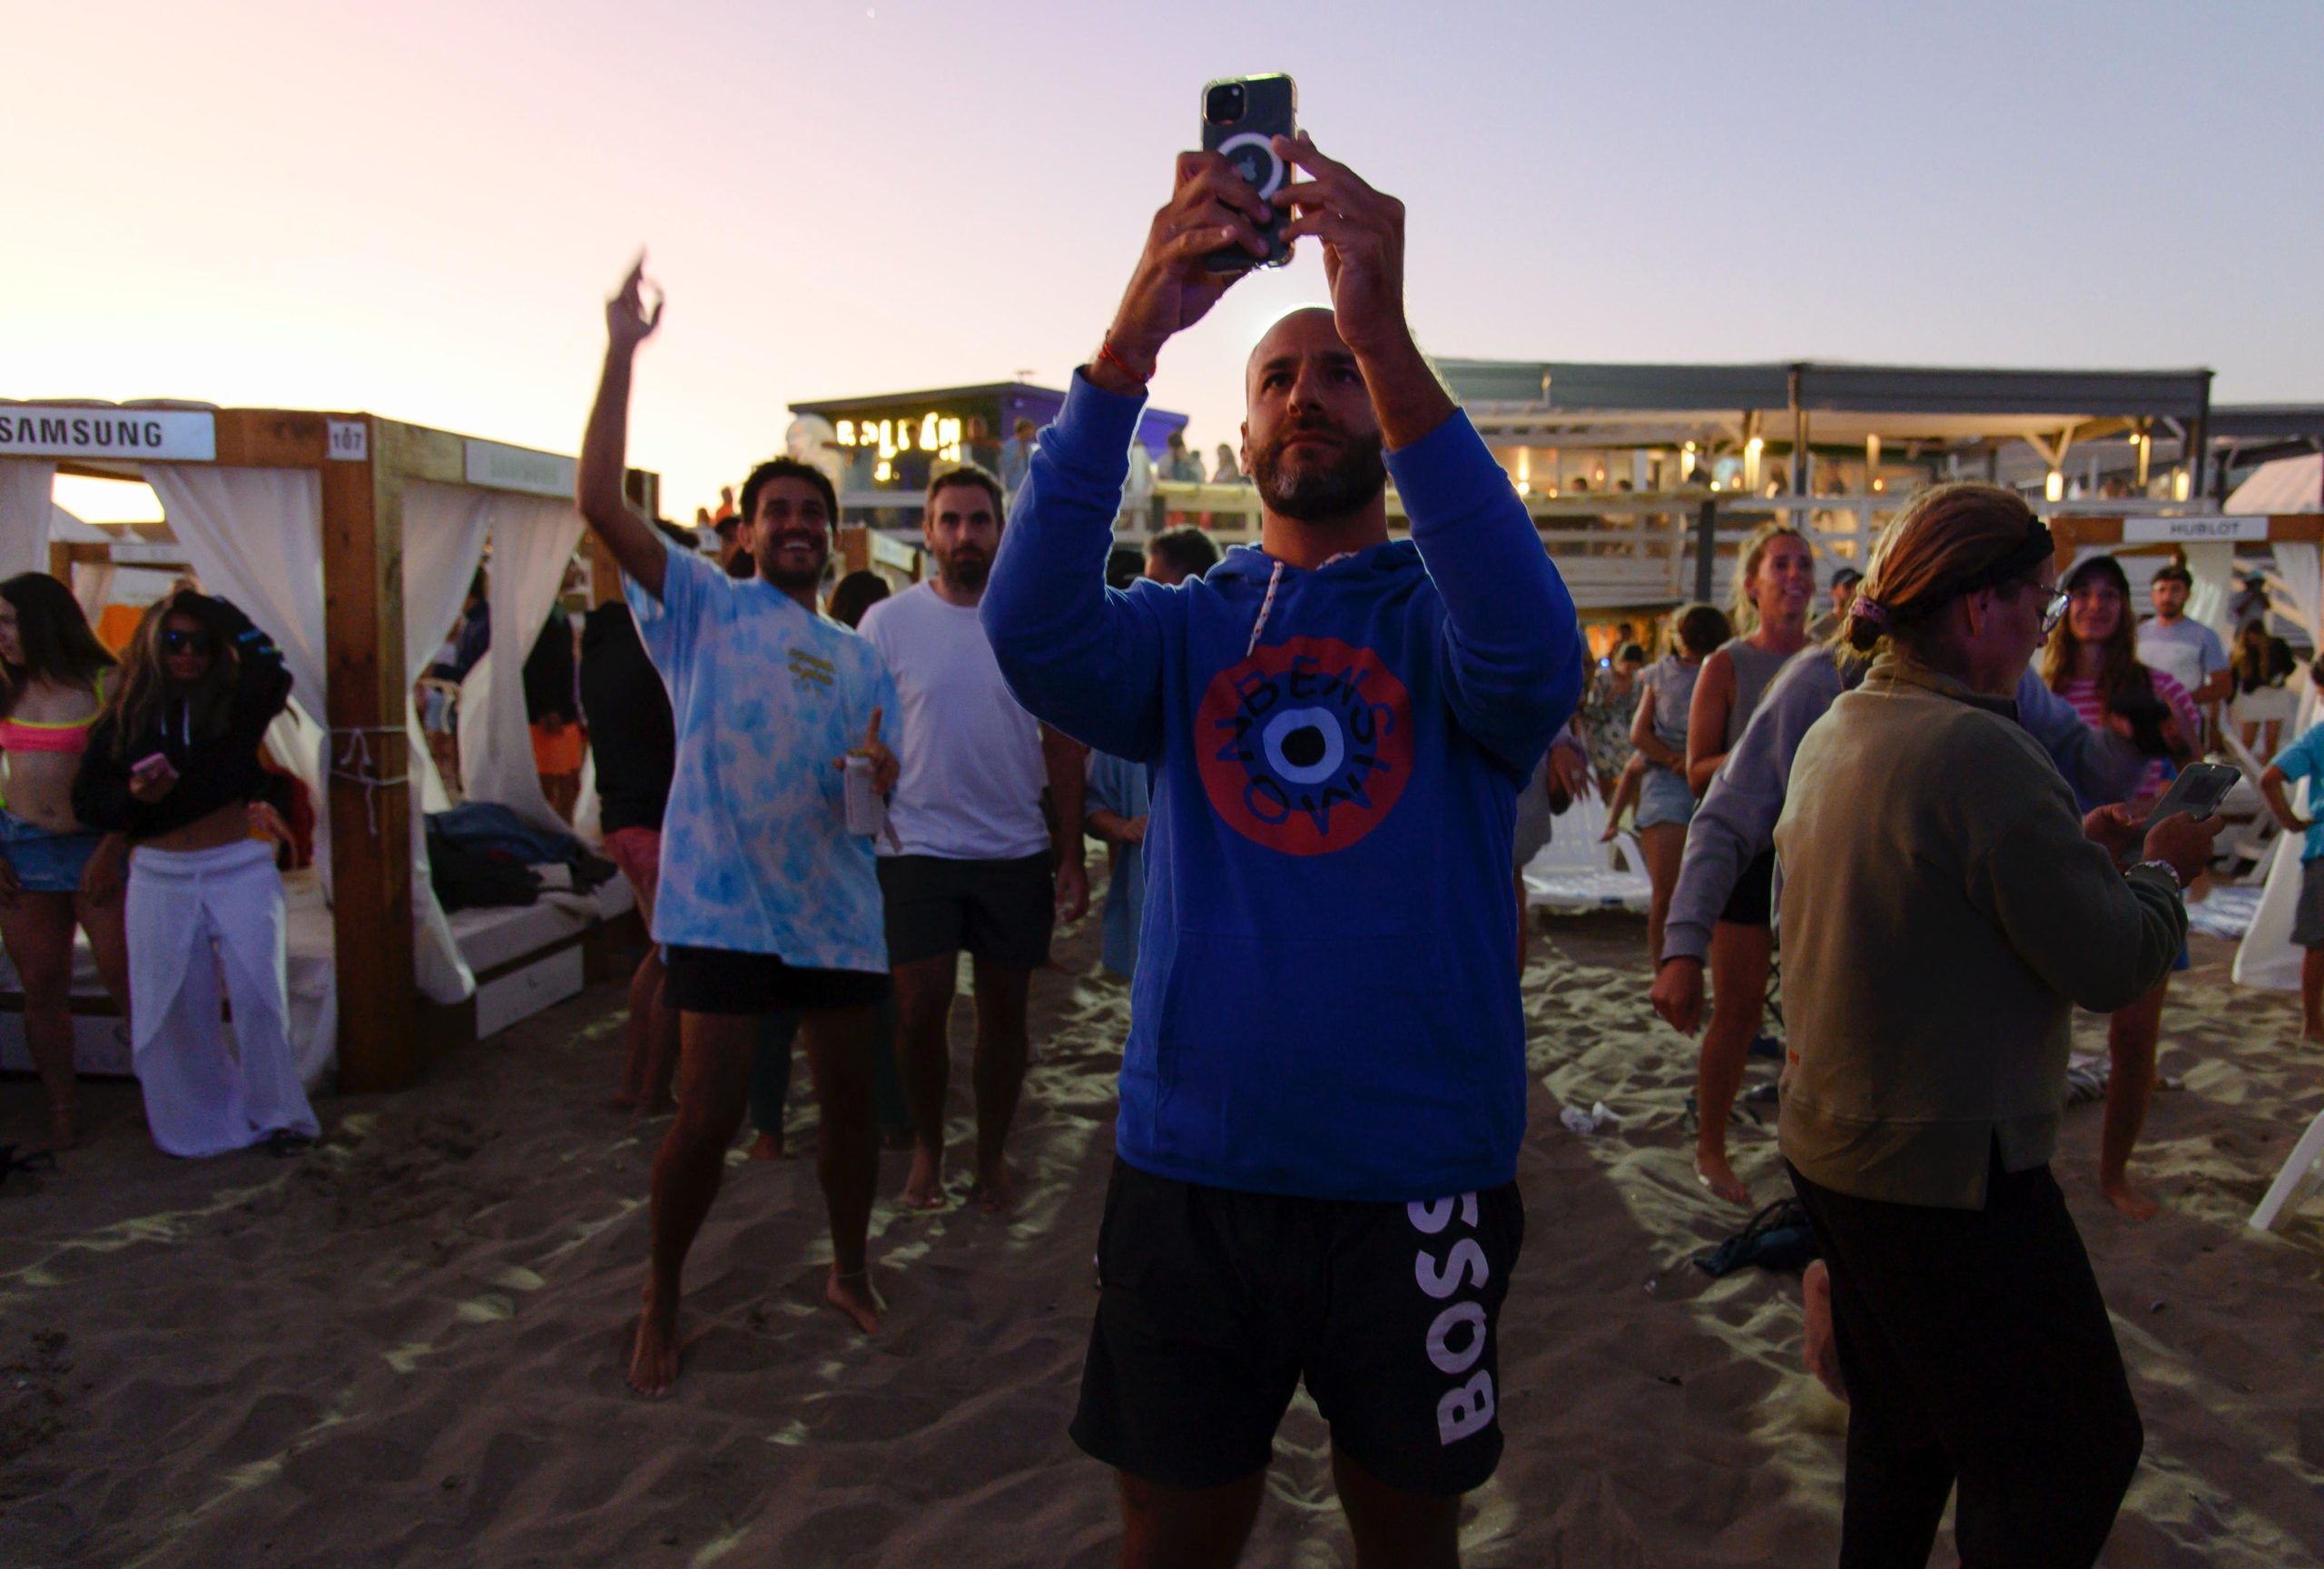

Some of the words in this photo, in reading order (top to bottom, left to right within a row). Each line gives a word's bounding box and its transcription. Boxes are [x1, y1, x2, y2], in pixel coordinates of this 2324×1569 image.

[0, 417, 162, 448] SAMSUNG
[2170, 520, 2240, 537] HUBLOT
[1407, 1190, 1495, 1446] BOSS
